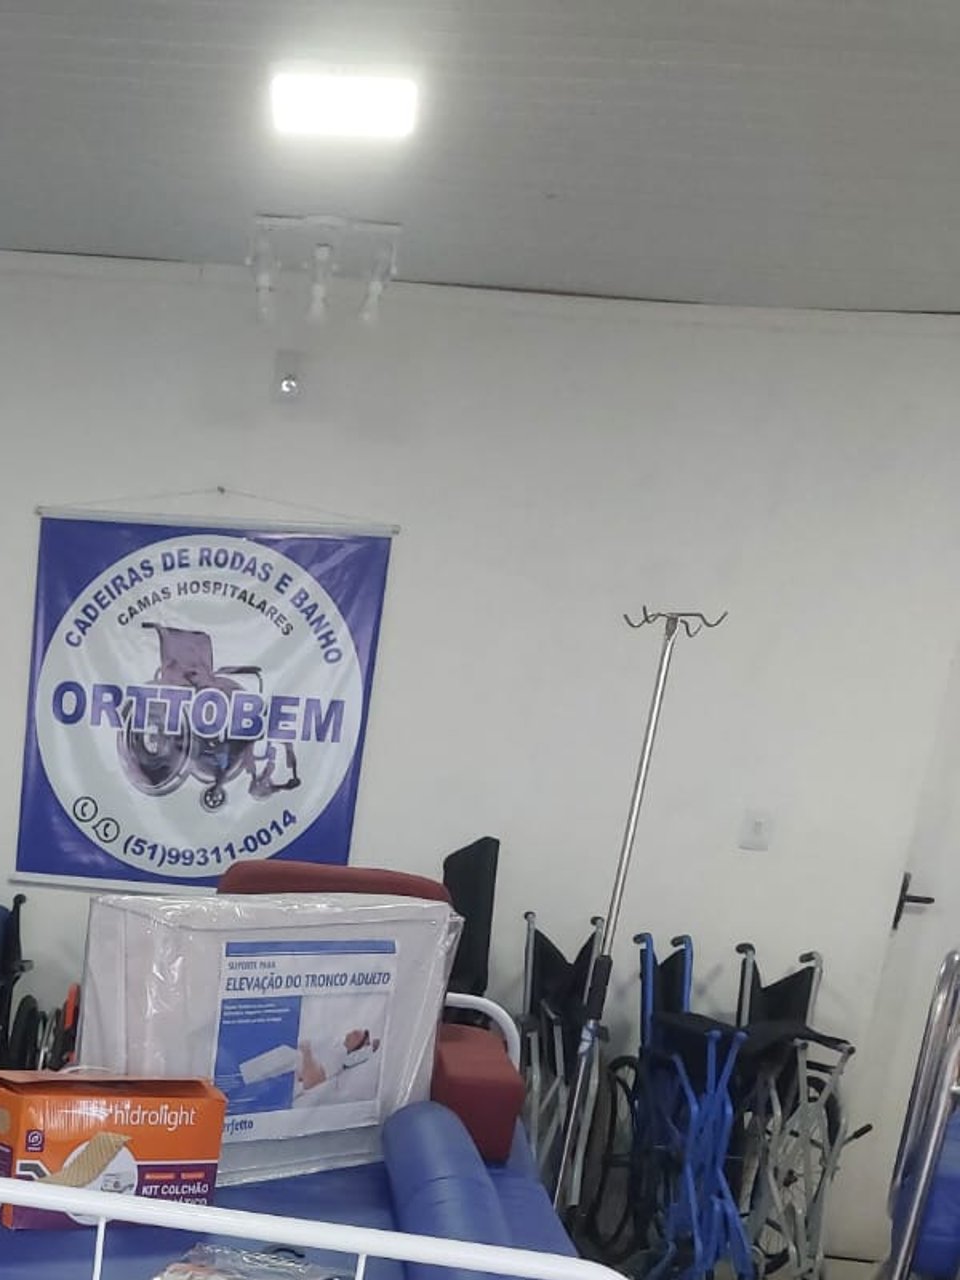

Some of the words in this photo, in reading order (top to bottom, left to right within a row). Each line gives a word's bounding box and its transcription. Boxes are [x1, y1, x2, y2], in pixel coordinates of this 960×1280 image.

[65, 559, 155, 647] CADEIRAS
[161, 549, 190, 571] DE
[199, 548, 273, 582] RODAS
[274, 573, 293, 594] E
[291, 587, 343, 663] BANHO
[117, 586, 171, 626] CAMAS
[177, 581, 293, 636] HOSPITALARES
[52, 680, 345, 744] ORTTOBEM
[123, 809, 297, 867] (51)99311-0014
[225, 972, 283, 994] ELEVAÇÃO
[285, 975, 301, 988] DO
[305, 973, 348, 987] TRONCO
[349, 972, 391, 986] ADULTO
[114, 1103, 197, 1131] hidrolight
[142, 1185, 160, 1195] KIT
[161, 1181, 209, 1195] COLCHÃO
